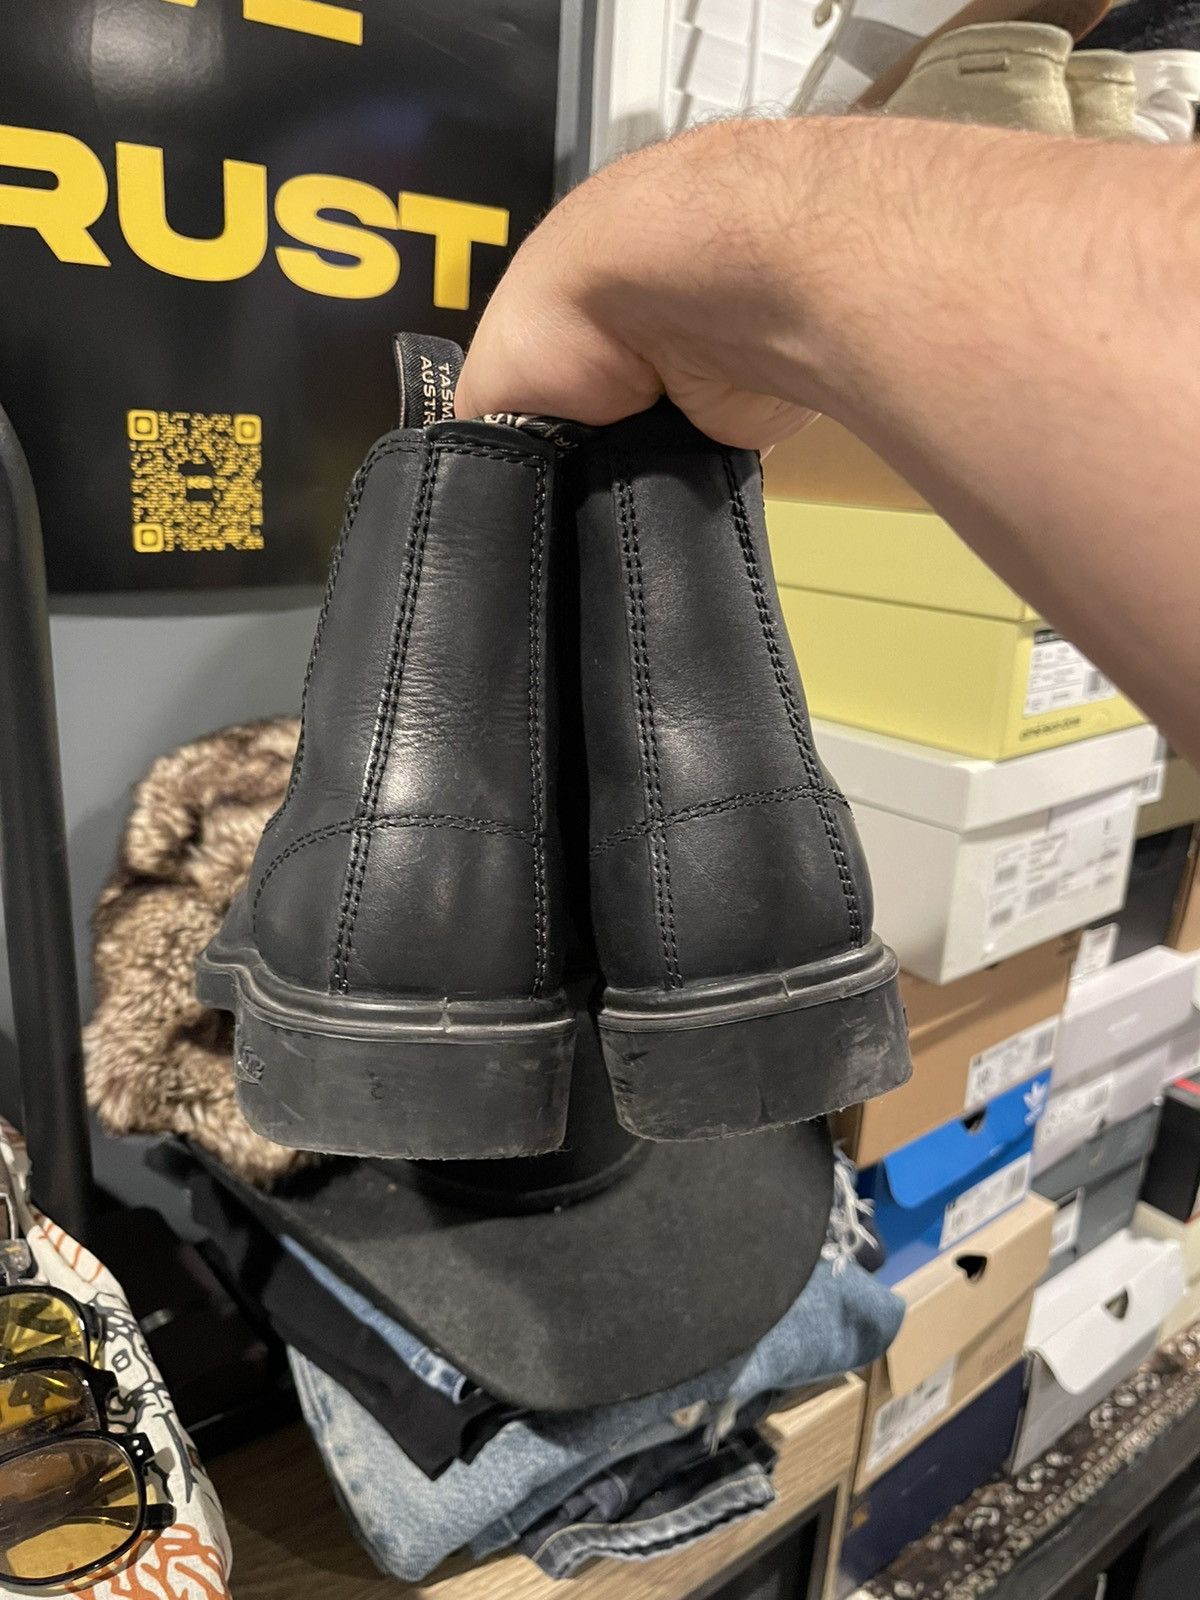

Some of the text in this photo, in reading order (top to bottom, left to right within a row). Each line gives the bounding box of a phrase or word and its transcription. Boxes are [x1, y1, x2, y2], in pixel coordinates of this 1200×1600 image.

[0, 124, 510, 310] RUST
[420, 355, 437, 425] AUSTR
[438, 362, 454, 419] TASM
